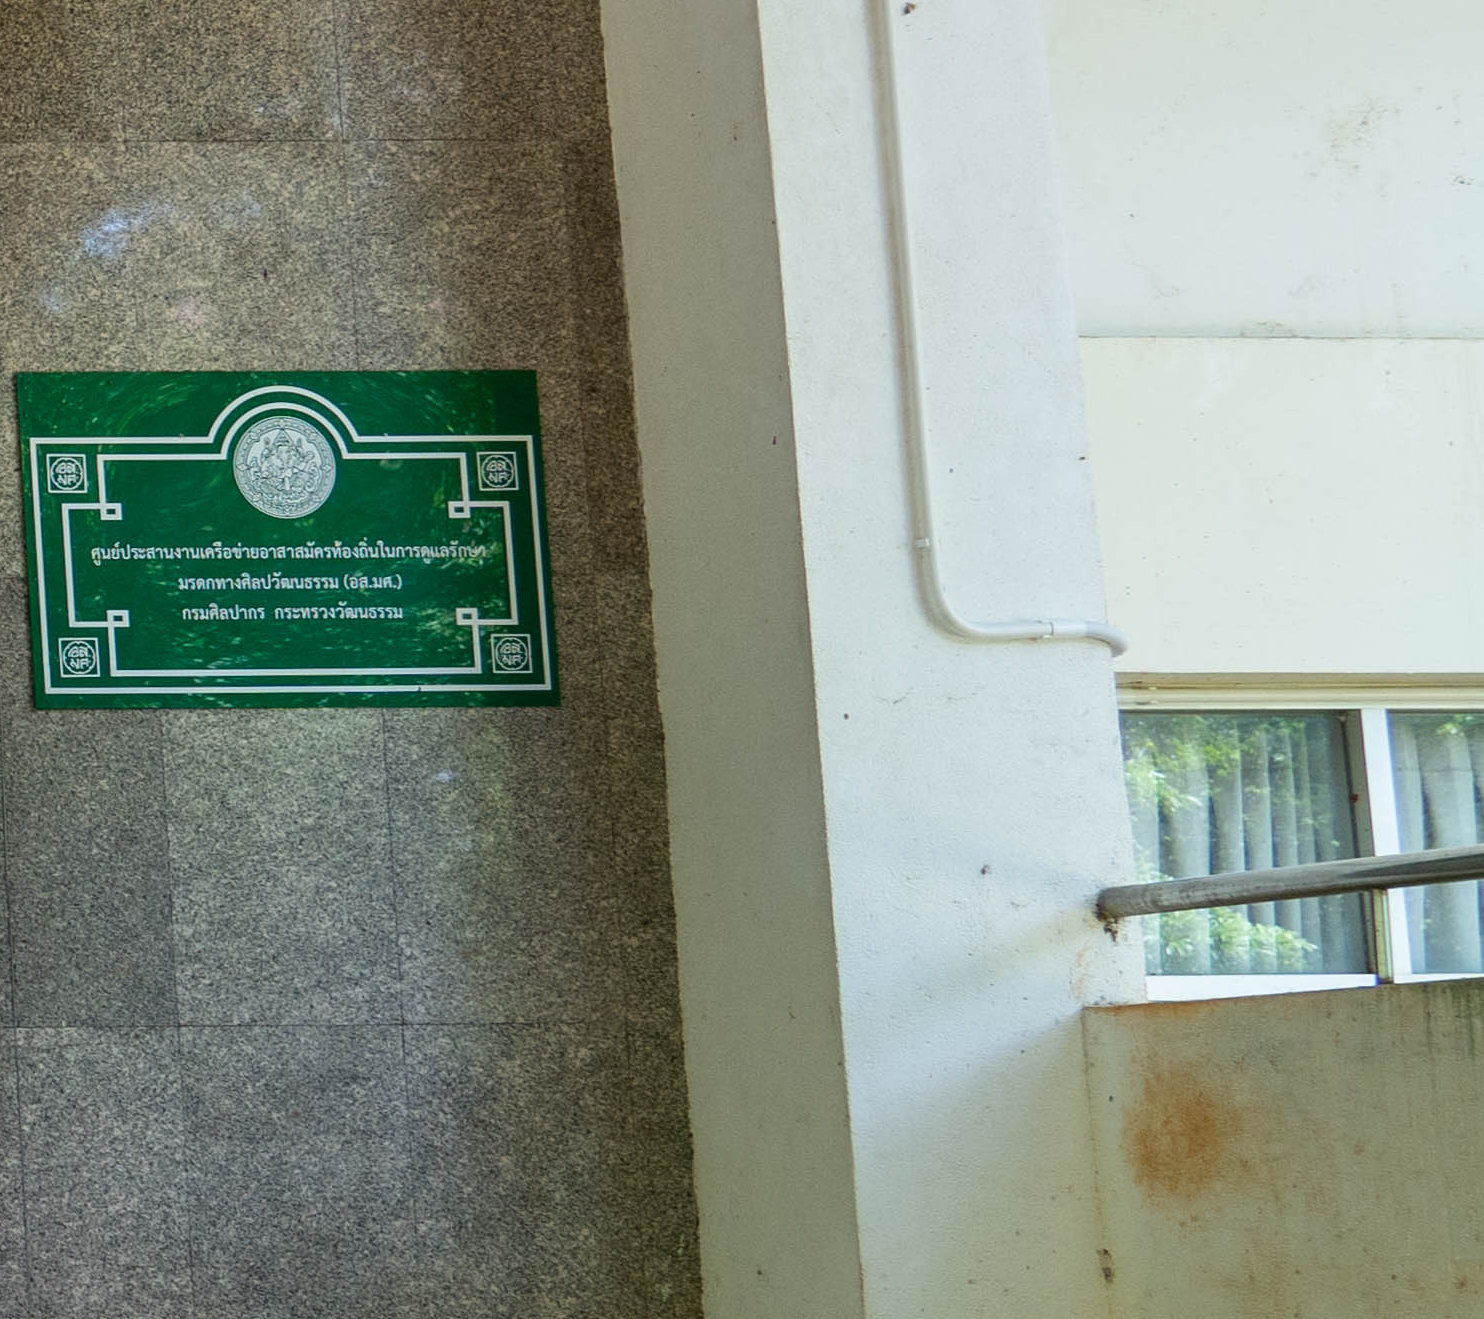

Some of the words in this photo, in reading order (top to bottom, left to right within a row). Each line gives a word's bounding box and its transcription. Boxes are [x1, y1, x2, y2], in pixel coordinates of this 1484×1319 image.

[178, 571, 339, 590] มรดกทางศิลปวัฒนธรรม
[182, 602, 266, 621] กรมศิลปากร
[274, 601, 403, 620] กระทรวงวัฒนธรรม
